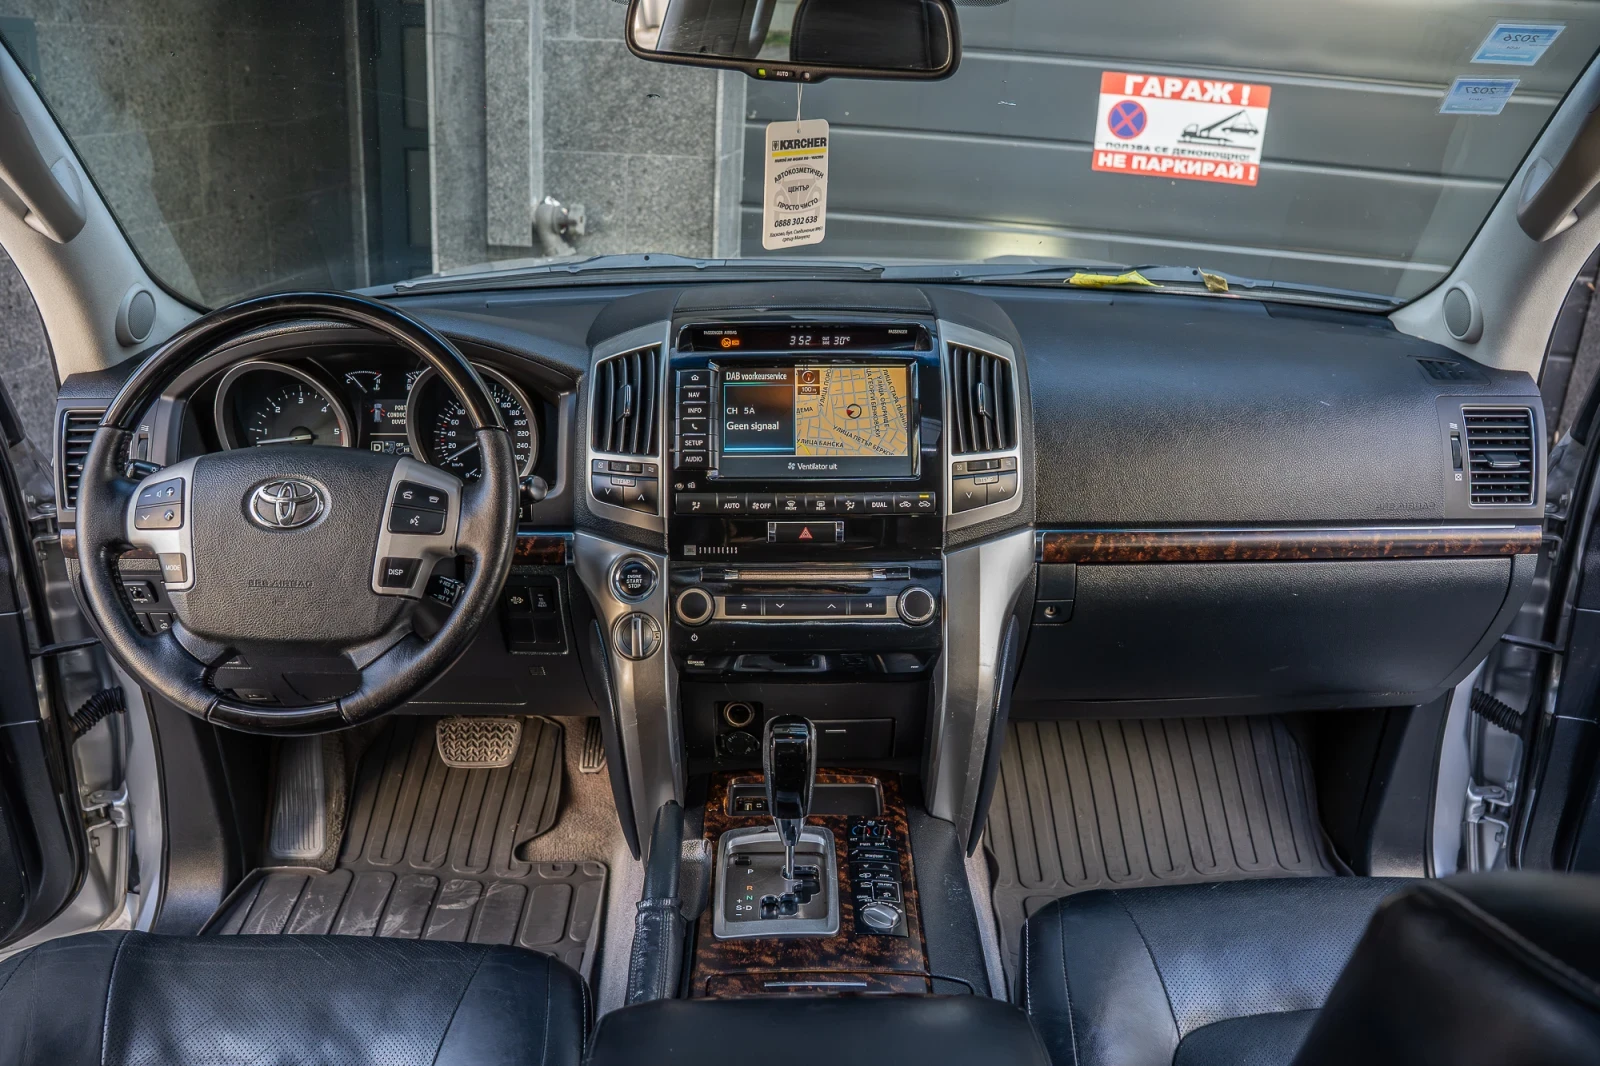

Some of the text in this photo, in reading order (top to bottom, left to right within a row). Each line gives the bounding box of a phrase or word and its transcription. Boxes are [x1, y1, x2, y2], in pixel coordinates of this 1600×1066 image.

[1124, 75, 1234, 104] ГАРАЖ
[1097, 152, 1127, 169] НЕ
[1131, 154, 1244, 180] ПАРКИРАЙ
[774, 167, 824, 184] АВТОКОЗМЕТИЧЕН
[787, 184, 810, 194] ЦЕНТЪР
[777, 201, 800, 211] ПРОСТО
[791, 216, 805, 226] 302
[805, 215, 818, 224] 638
[725, 371, 788, 381] DAB voorkeurservice
[726, 407, 756, 415] CH 5A
[726, 421, 779, 432] Geen signaal
[797, 462, 828, 471] Ventilator
[388, 568, 404, 576] DISP
